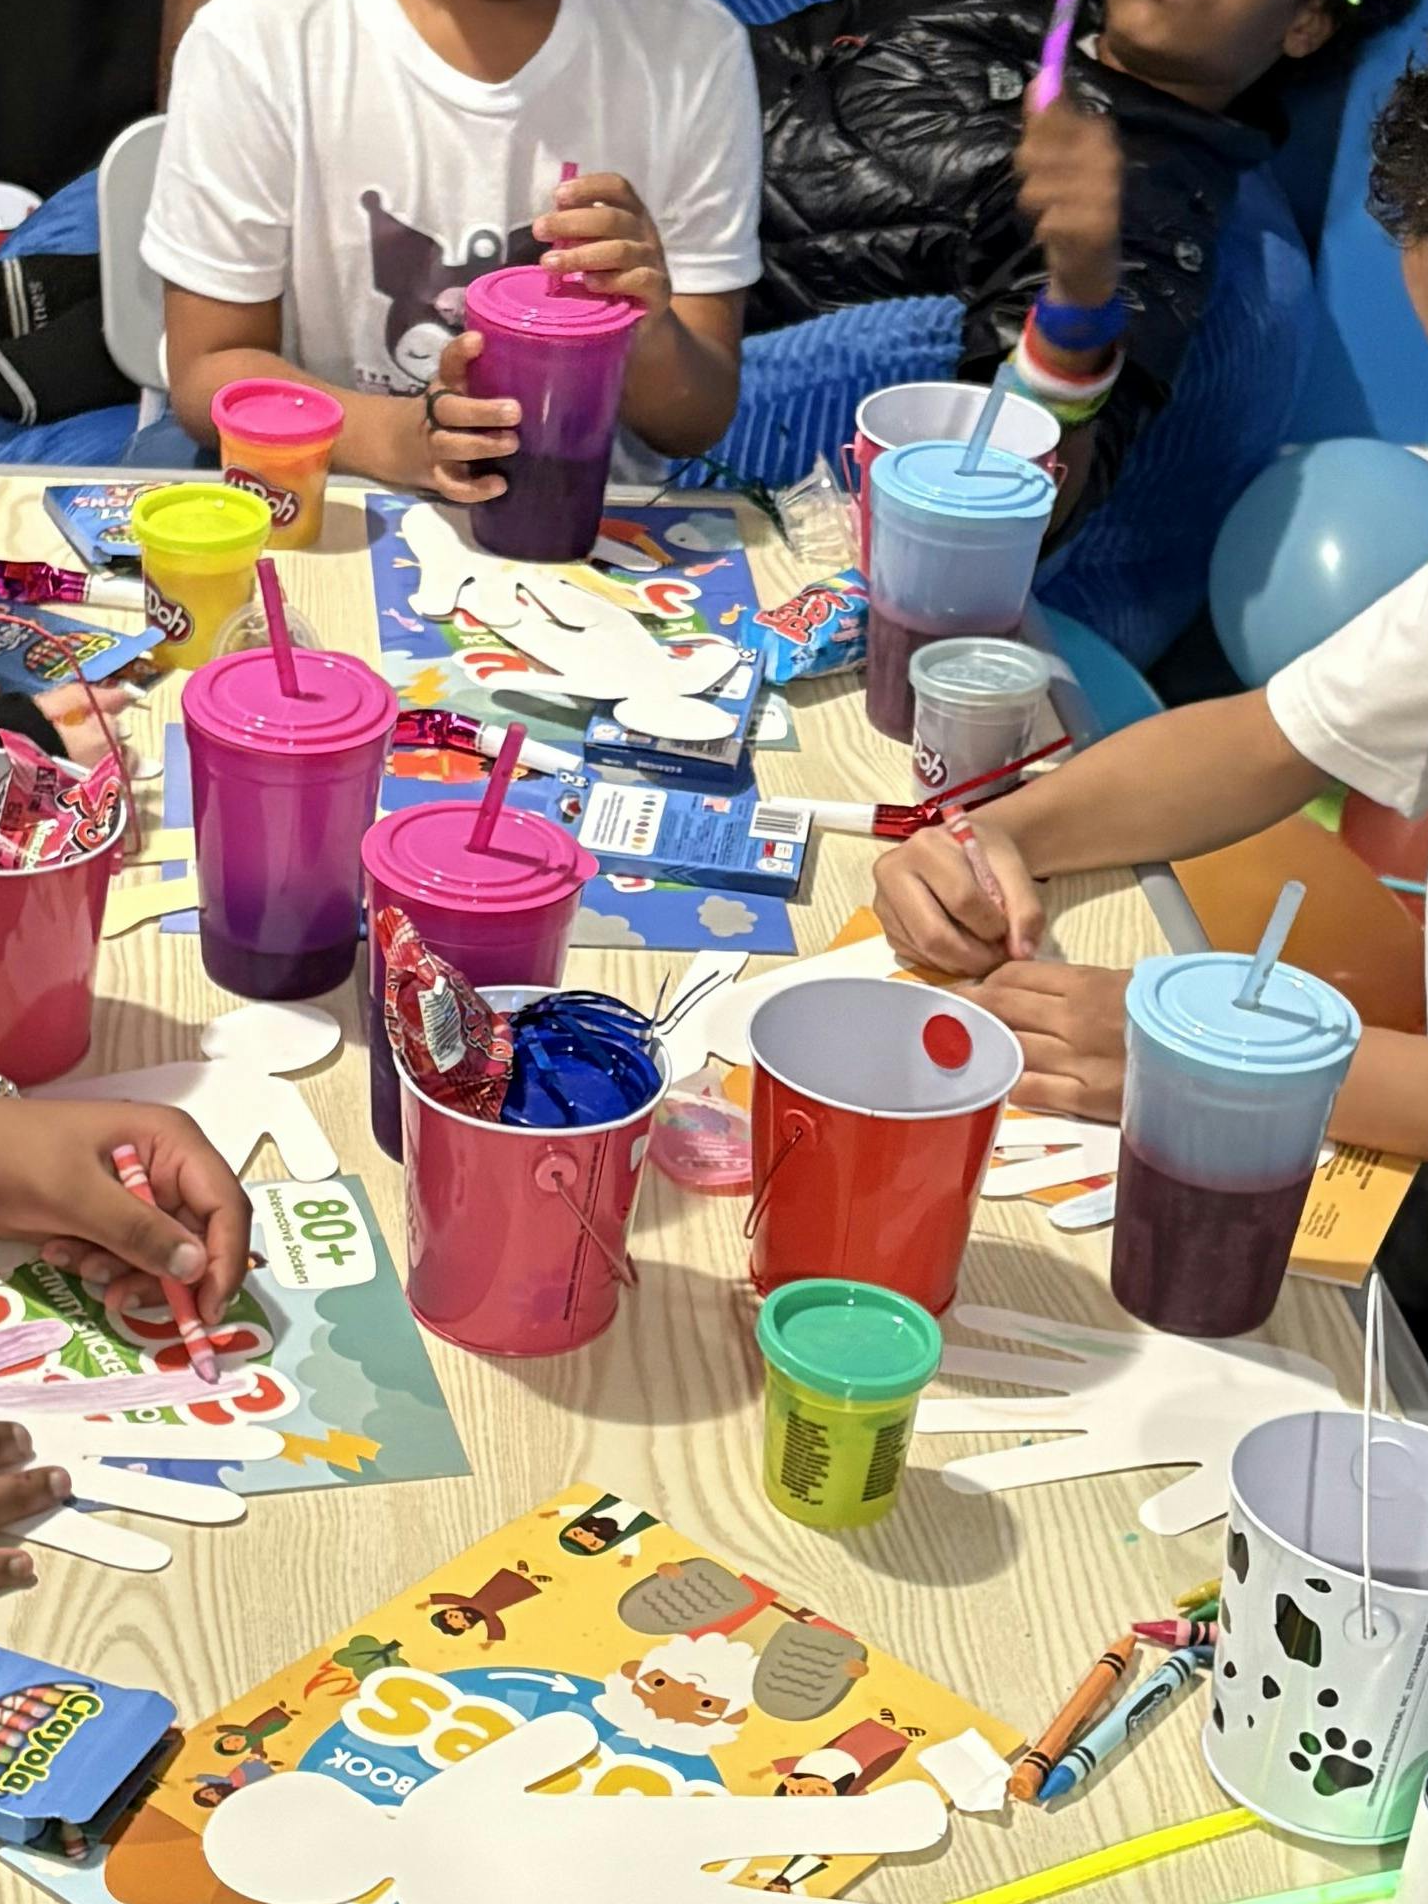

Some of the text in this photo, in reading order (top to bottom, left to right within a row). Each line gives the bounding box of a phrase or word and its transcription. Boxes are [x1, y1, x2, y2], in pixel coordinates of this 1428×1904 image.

[292, 1199, 357, 1266] 80+
[29, 1261, 87, 1332] CTIVITY
[325, 1745, 420, 1796] BOOK
